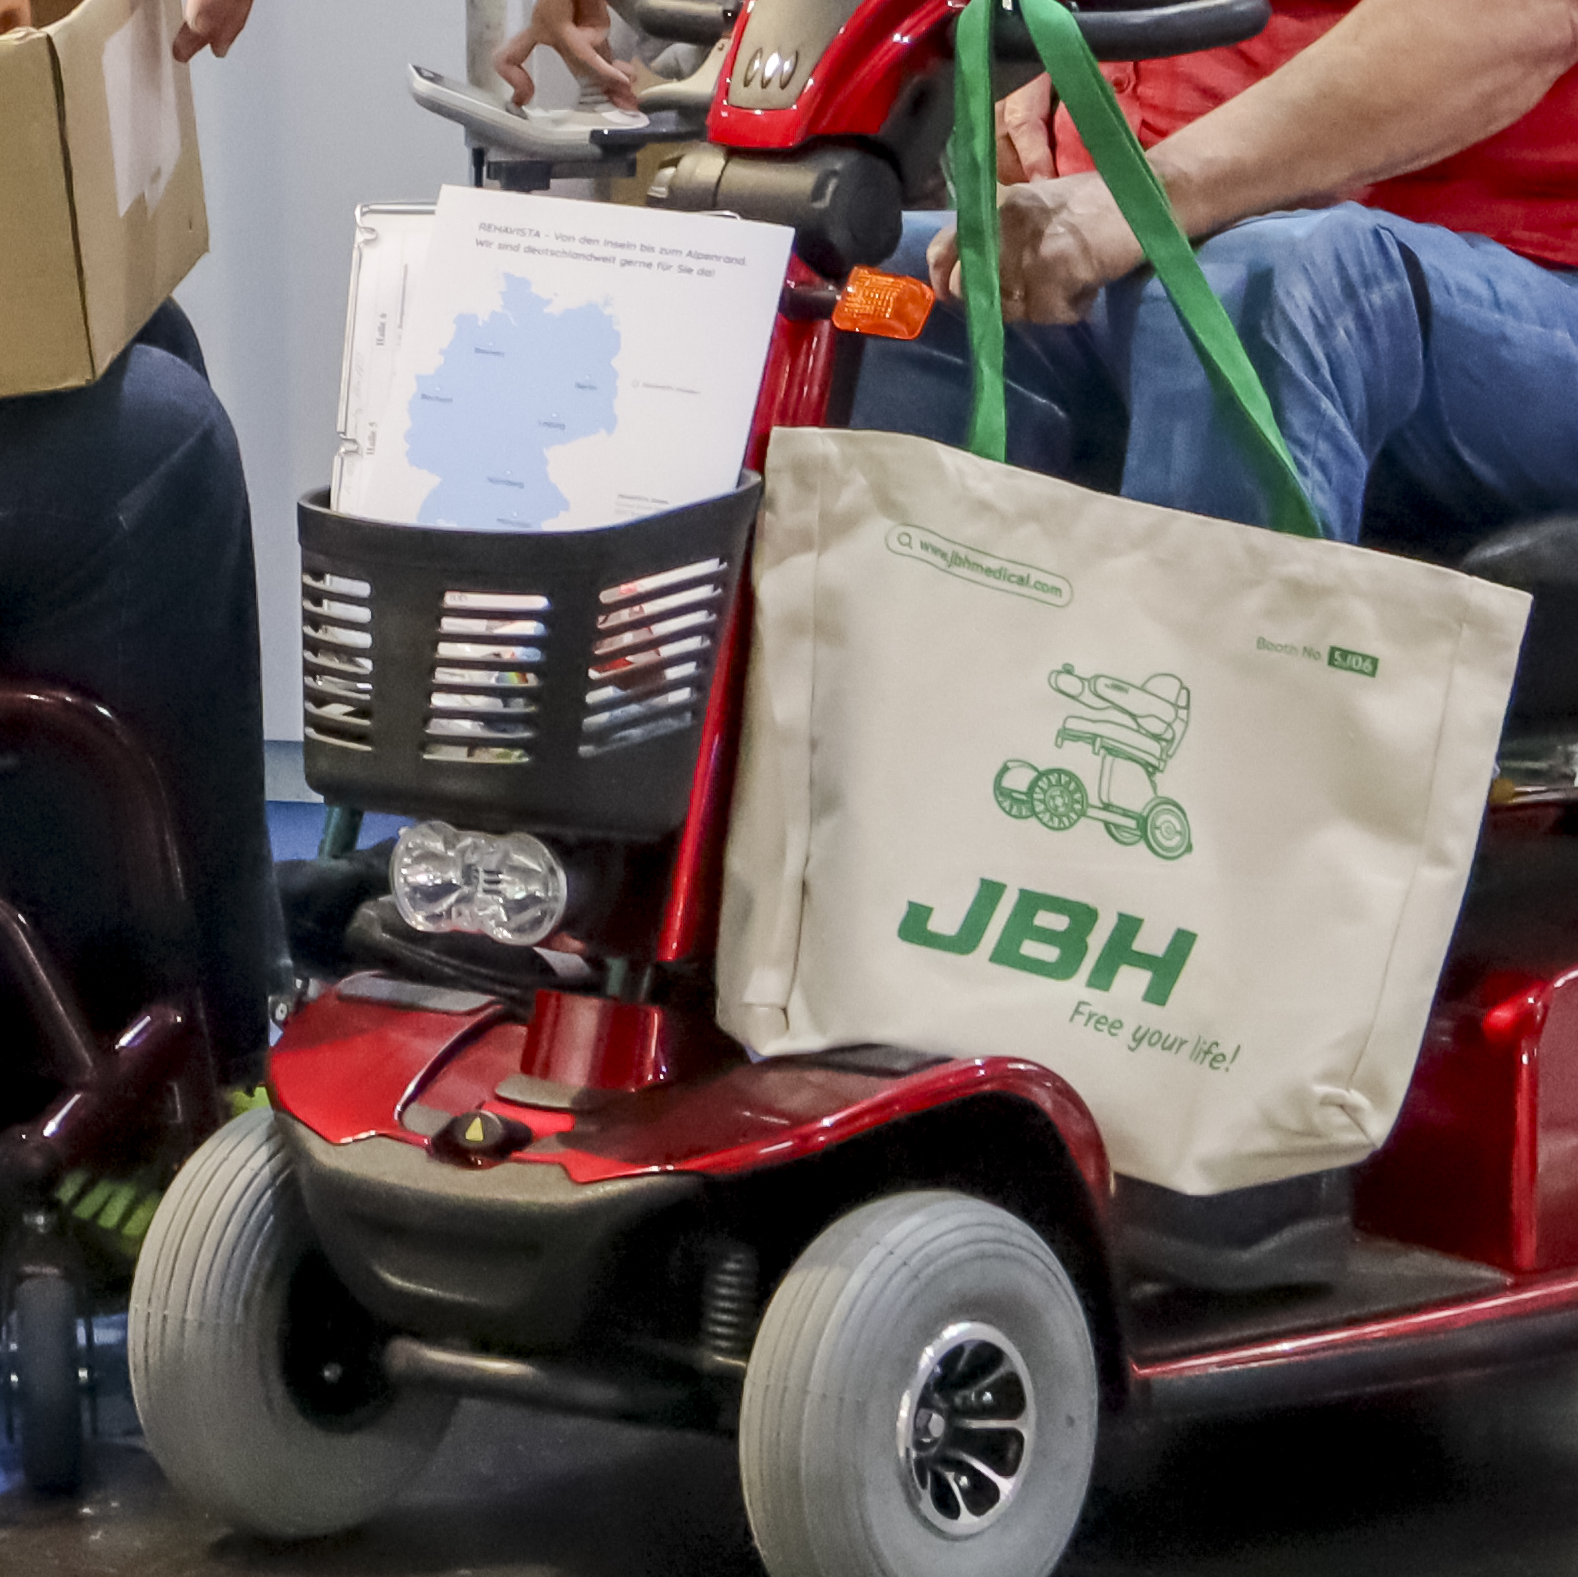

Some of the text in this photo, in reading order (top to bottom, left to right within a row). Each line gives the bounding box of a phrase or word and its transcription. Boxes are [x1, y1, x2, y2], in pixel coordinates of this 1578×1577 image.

[919, 537, 1063, 599] www.jbhmedical.com
[1256, 635, 1299, 657] Booth
[897, 877, 1199, 1007] JBH
[1068, 1000, 1242, 1073] Free your life!
